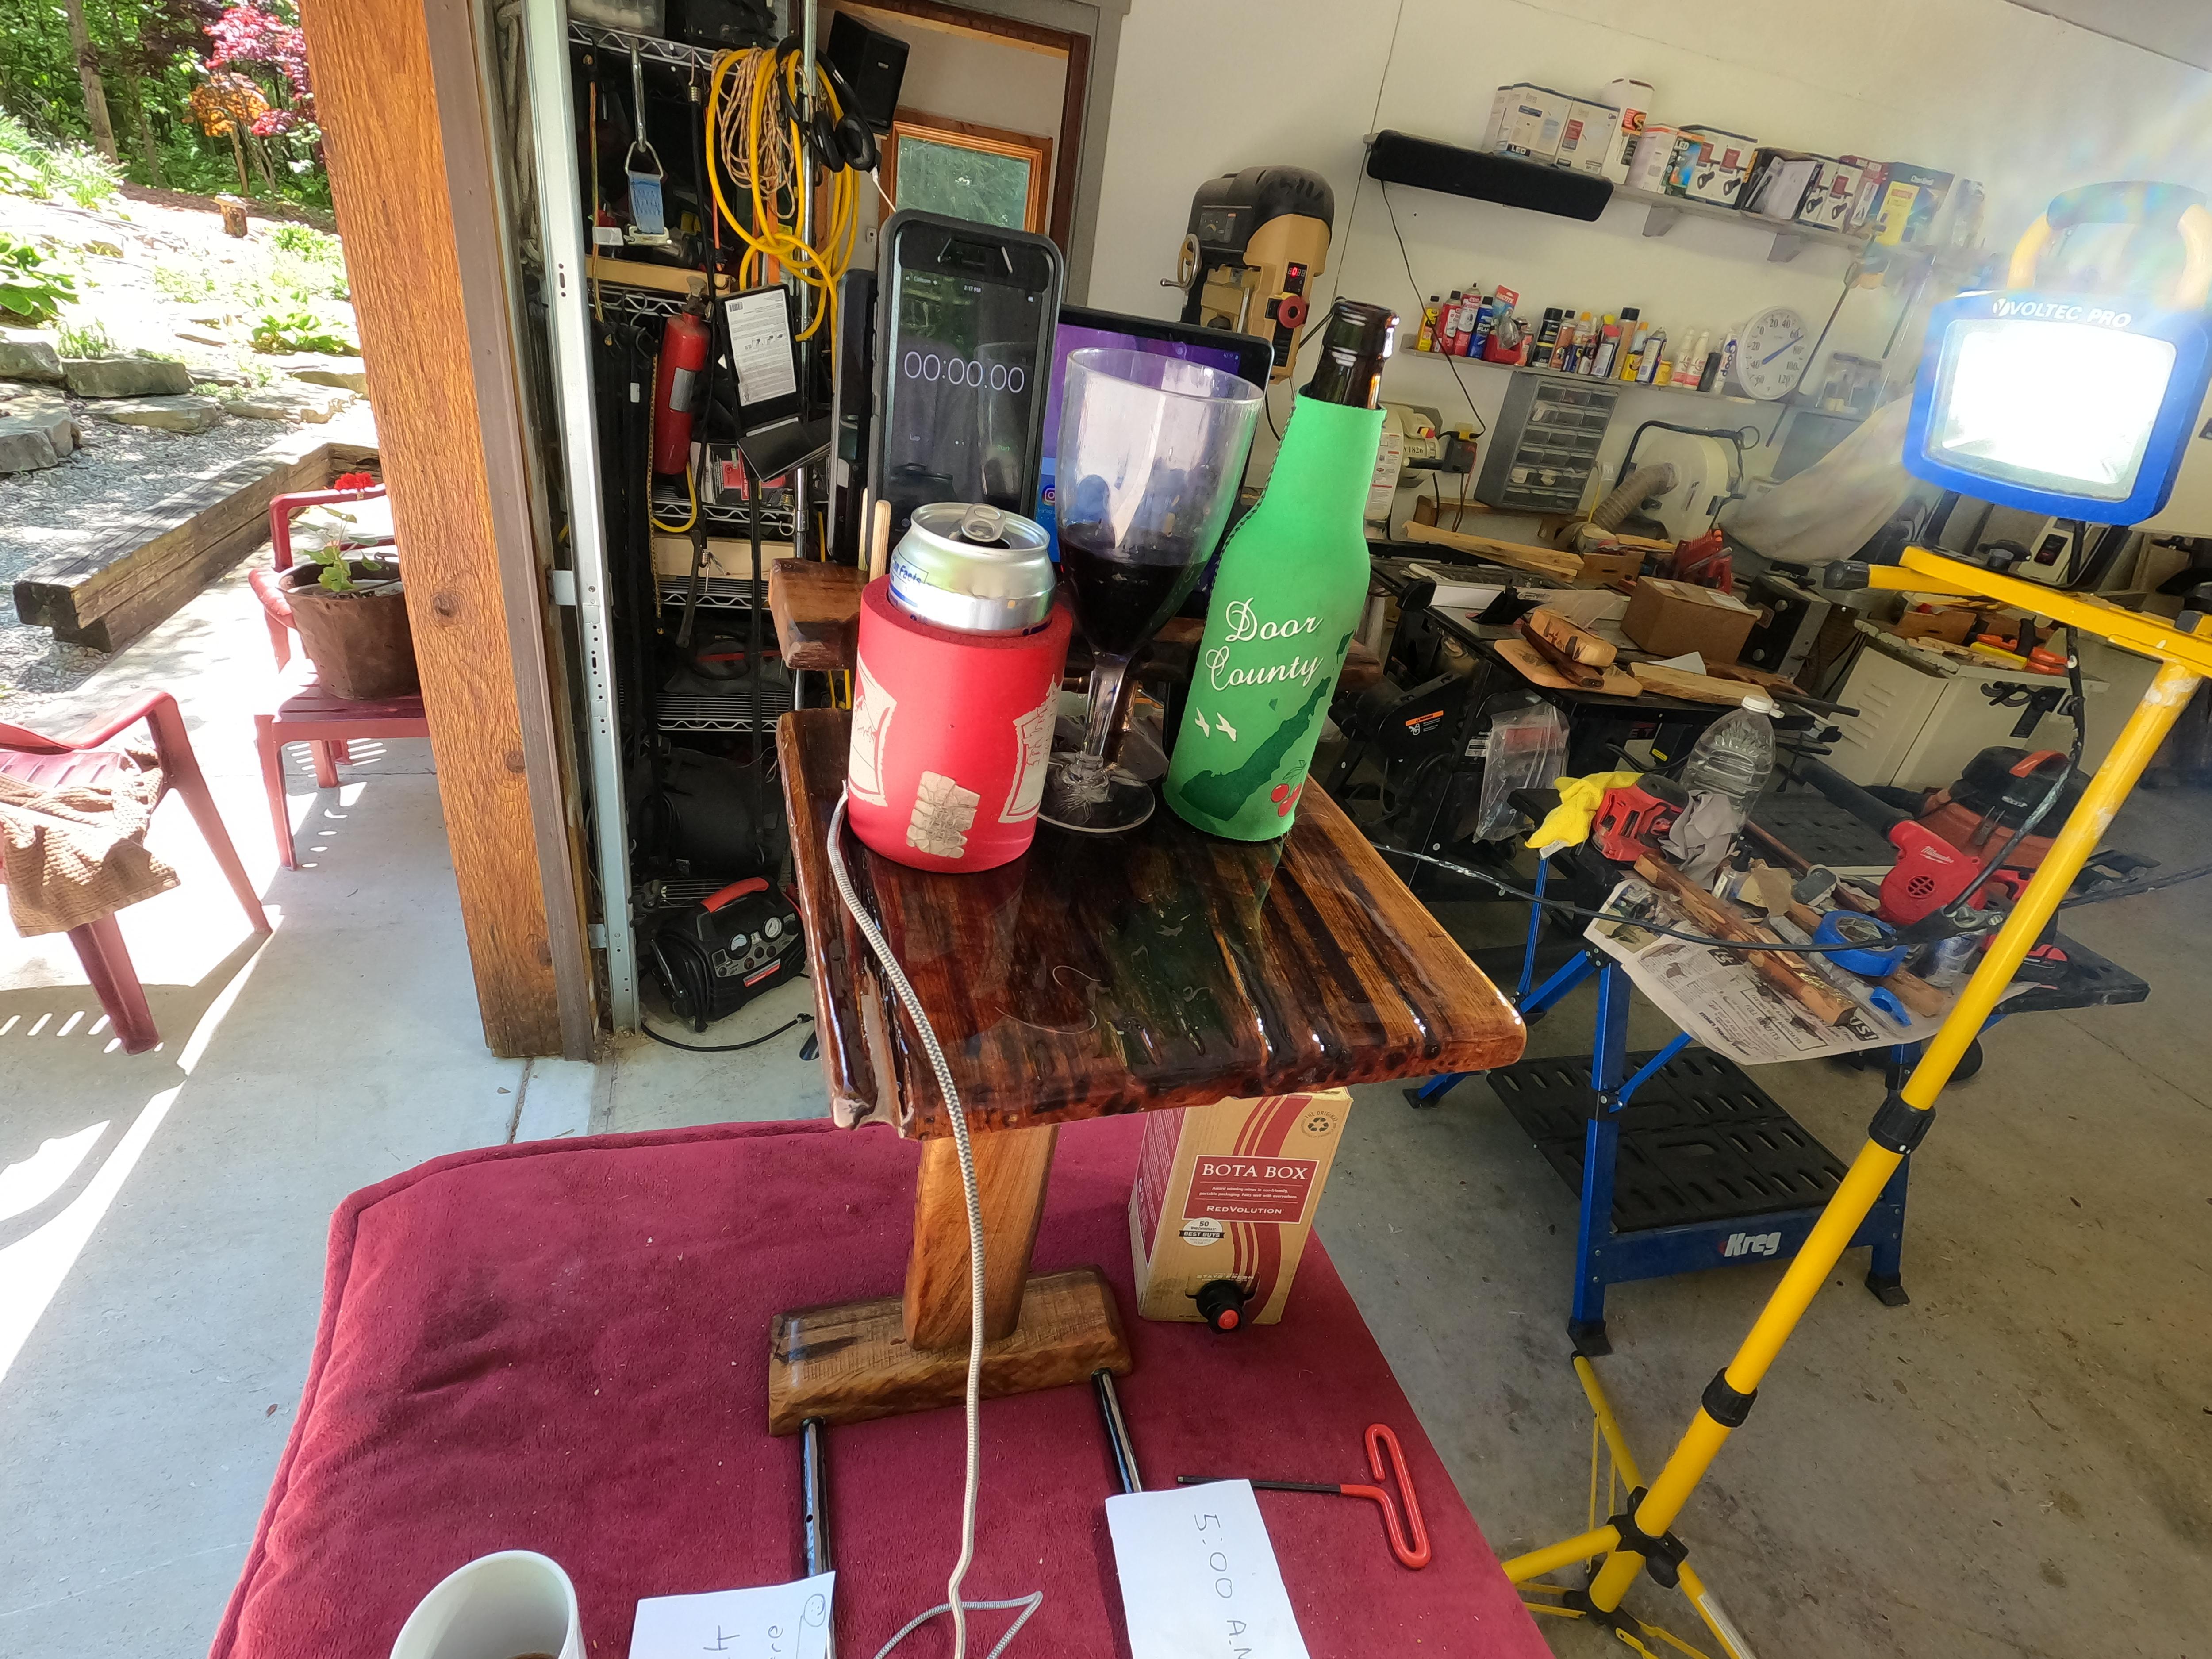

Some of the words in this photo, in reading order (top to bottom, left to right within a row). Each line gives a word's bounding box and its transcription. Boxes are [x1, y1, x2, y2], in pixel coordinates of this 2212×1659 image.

[1511, 145, 1527, 154] LED
[1674, 139, 1690, 151] LED
[1770, 319, 1778, 327] 20
[1782, 319, 1791, 328] 40
[2011, 301, 2083, 321] VOLTEC
[2086, 308, 2132, 328] PRO
[1759, 326, 1765, 335] 0
[904, 351, 1024, 393] 00:00.00
[1225, 597, 1323, 641] Door
[1205, 645, 1324, 691] County
[1202, 1164, 1258, 1177] BOTA
[1264, 1166, 1308, 1180] BOX
[1724, 1232, 1781, 1257] Kreg
[1194, 1513, 1233, 1598] 5:00
